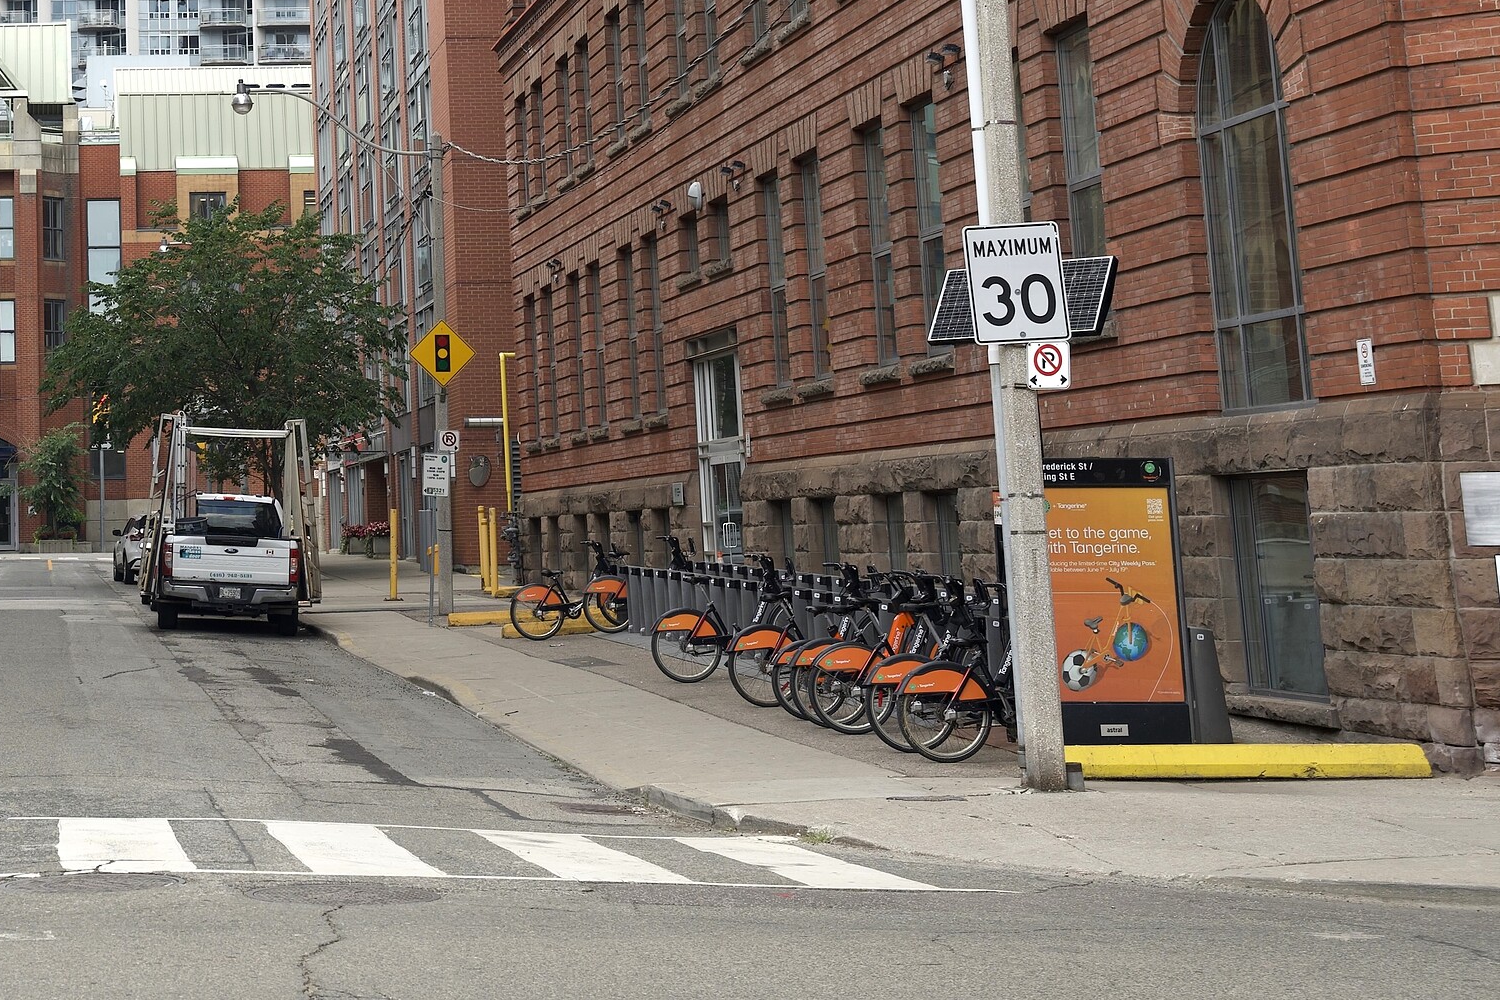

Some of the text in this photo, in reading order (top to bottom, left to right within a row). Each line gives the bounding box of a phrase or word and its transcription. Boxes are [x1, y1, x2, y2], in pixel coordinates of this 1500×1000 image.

[973, 237, 1052, 258] MAXIMUM
[981, 273, 1056, 326] 30
[1042, 462, 1076, 470] rederick
[1078, 462, 1087, 470] St
[1043, 473, 1056, 482] ing
[1049, 526, 1152, 541] et to the game,
[1069, 541, 1140, 556] Tangerine.
[891, 630, 901, 652] ngerine
